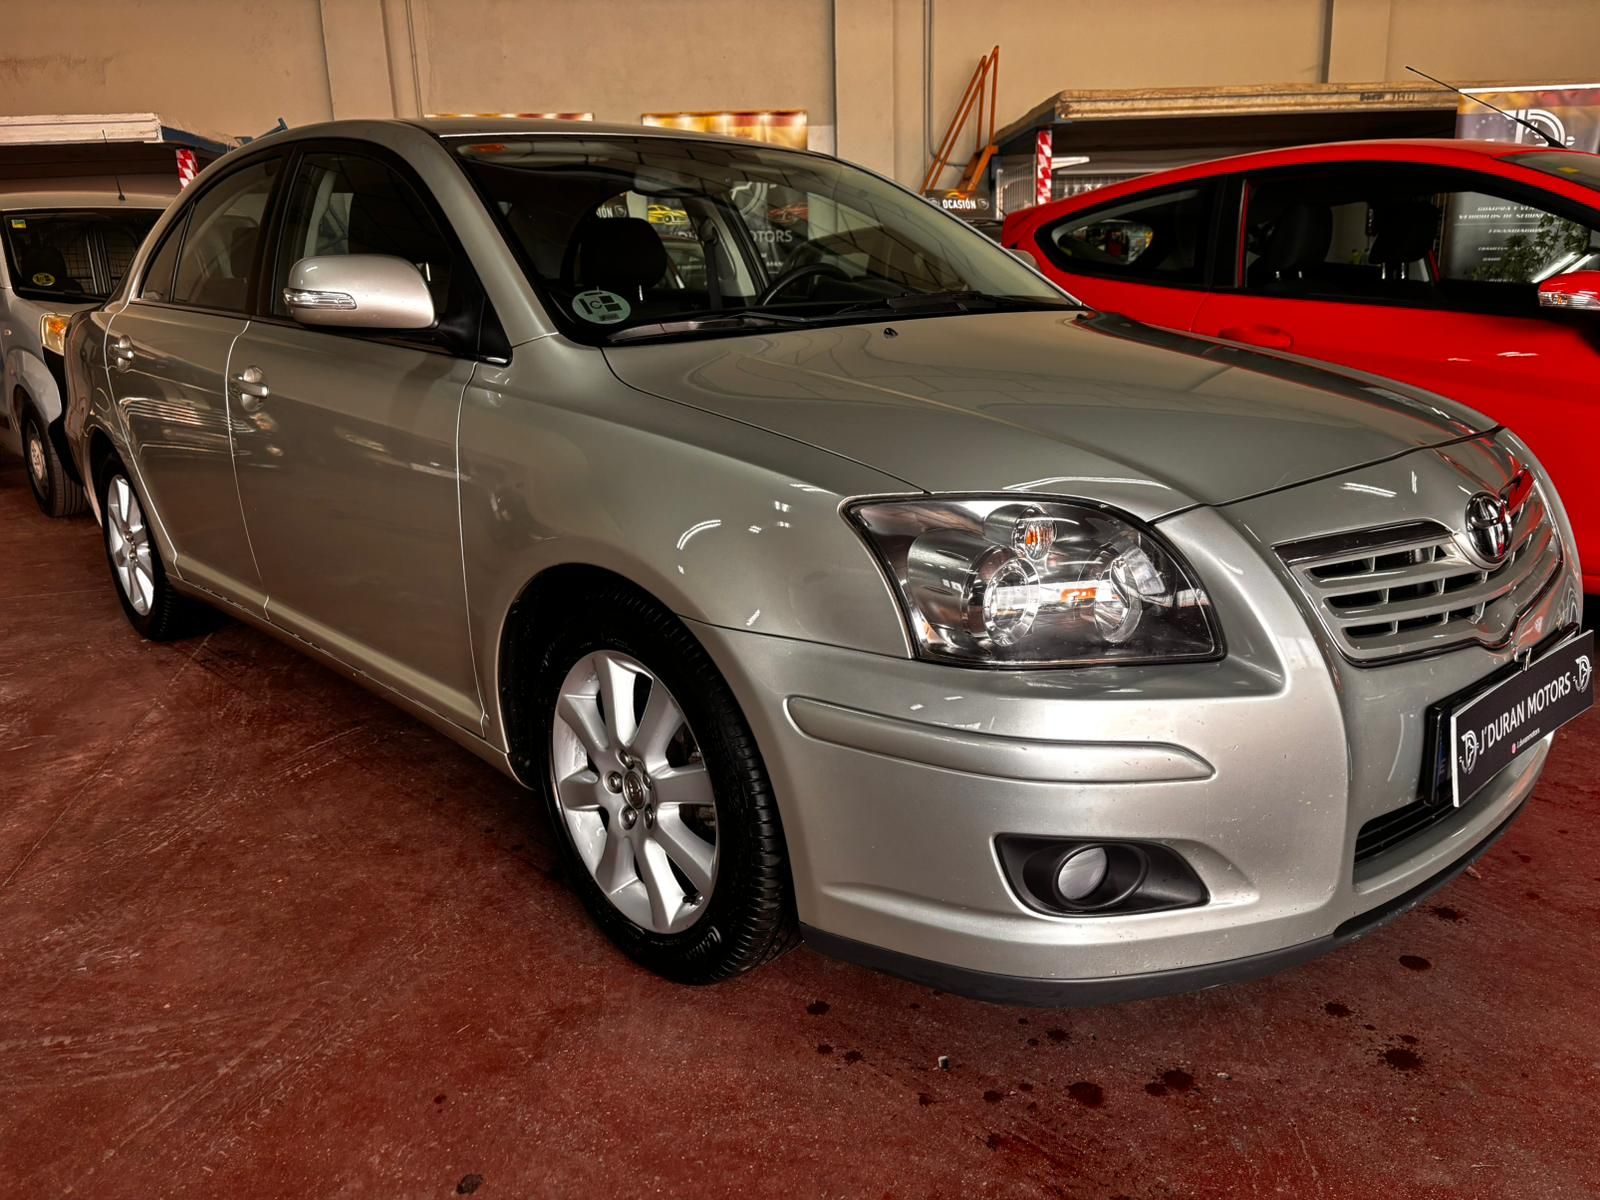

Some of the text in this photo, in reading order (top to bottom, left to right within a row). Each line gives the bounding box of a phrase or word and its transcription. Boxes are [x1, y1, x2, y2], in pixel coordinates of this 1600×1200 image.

[942, 198, 977, 209] OCASIÓN
[750, 230, 793, 243] OTORS
[1479, 700, 1525, 756] J'DURAN
[1527, 671, 1571, 719] MOTORS
